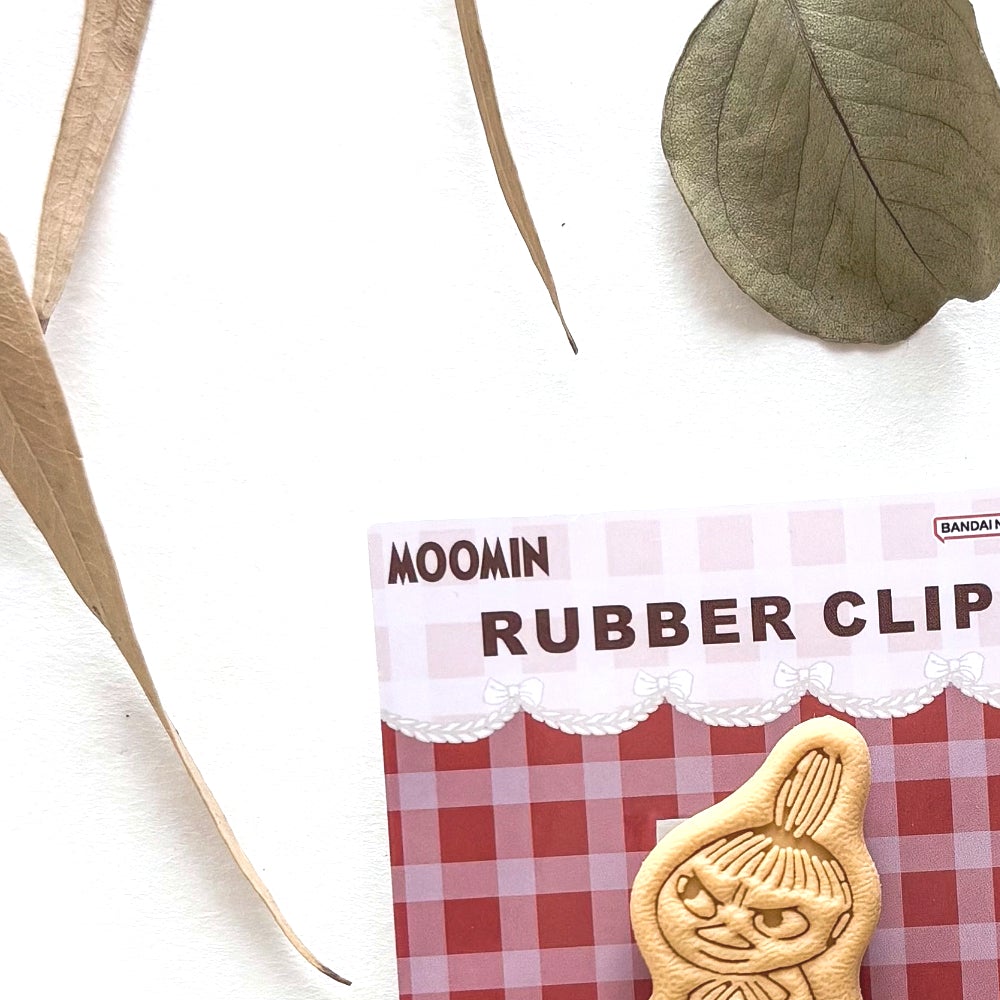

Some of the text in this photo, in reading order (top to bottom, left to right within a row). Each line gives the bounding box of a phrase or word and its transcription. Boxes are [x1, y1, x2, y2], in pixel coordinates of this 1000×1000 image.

[941, 519, 992, 533] BANDAI
[388, 537, 549, 584] MOOMIN
[481, 583, 992, 656] RUBBER CLIP
